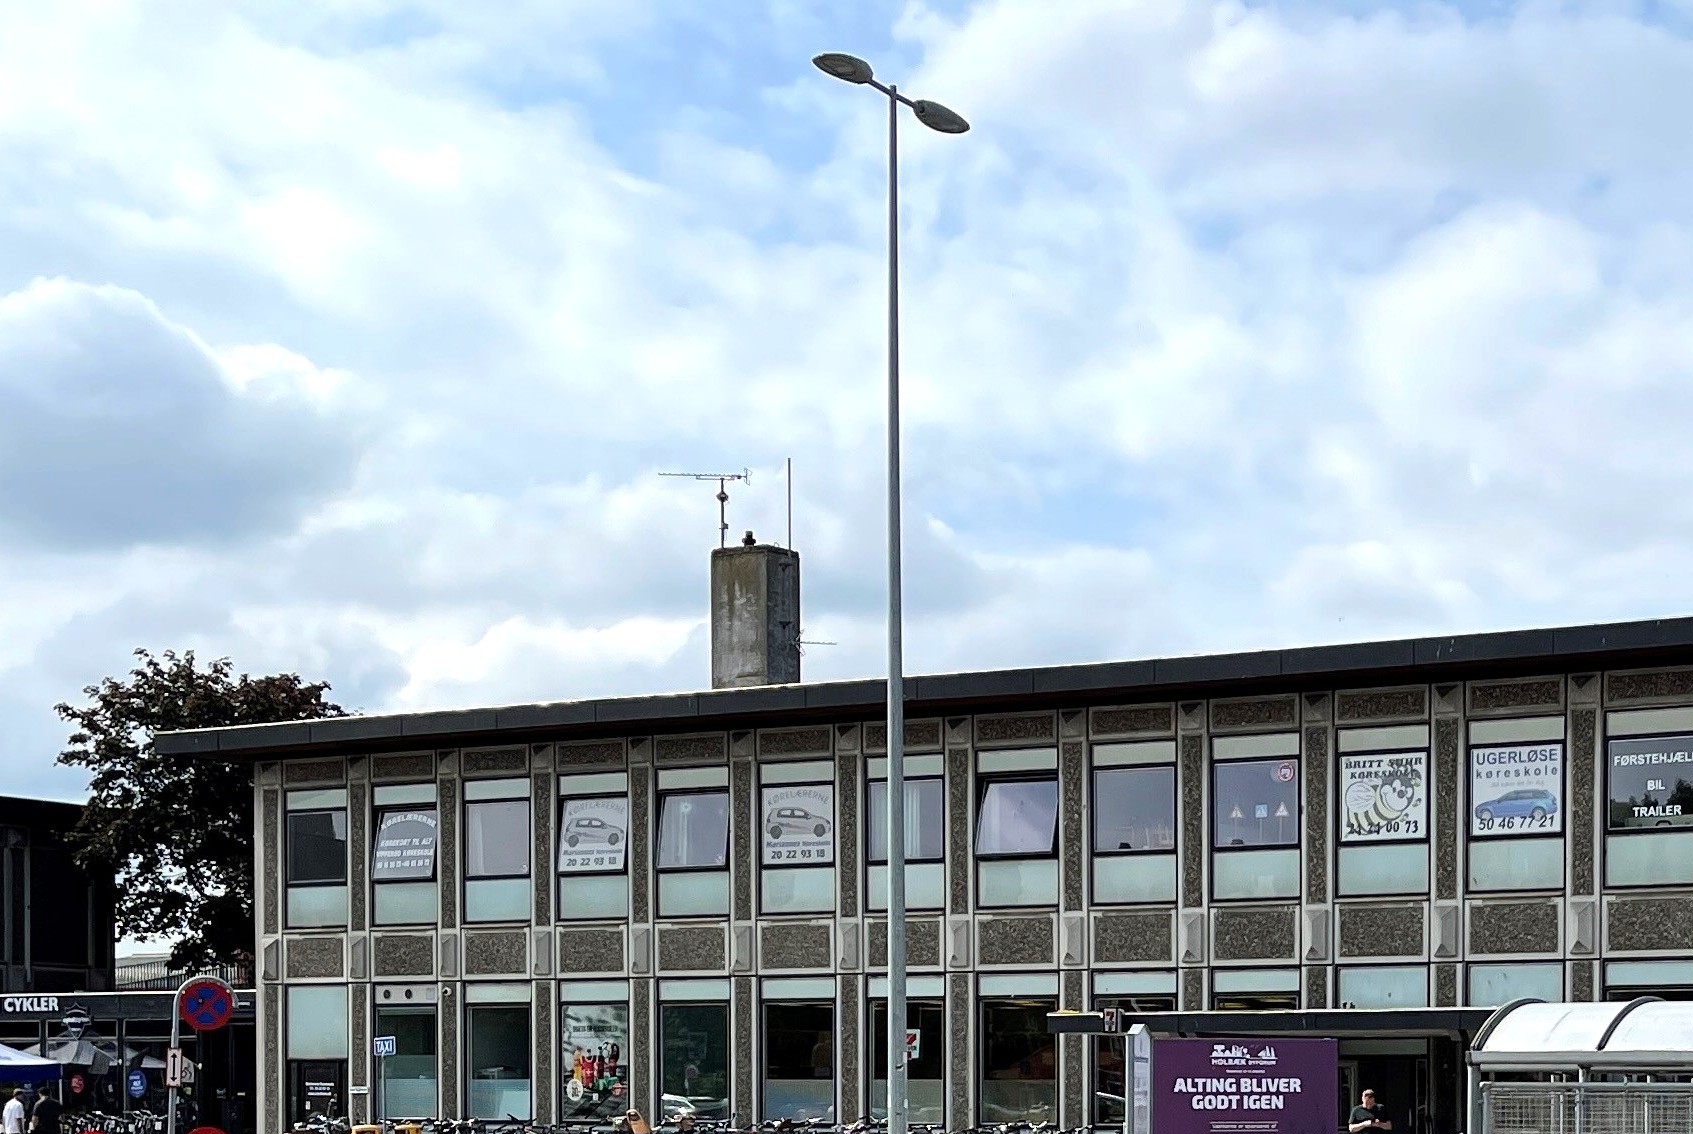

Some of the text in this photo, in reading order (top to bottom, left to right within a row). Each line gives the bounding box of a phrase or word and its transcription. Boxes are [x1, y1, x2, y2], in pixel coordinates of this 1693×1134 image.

[1345, 759, 1383, 769] BRITT
[1476, 749, 1558, 766] UGERLØSE
[1476, 765, 1558, 780] køreskole
[1647, 779, 1666, 791] BIL
[1632, 805, 1682, 818] TRAILER
[1386, 821, 1400, 833] 00
[1405, 819, 1419, 834] 73
[1478, 814, 1555, 831] 50 46 77 21
[566, 858, 577, 867] 20
[580, 857, 591, 866] 22
[593, 856, 605, 866] 93
[771, 850, 783, 860] 20
[786, 849, 797, 859] 22
[800, 849, 812, 859] 93
[4, 997, 59, 1013] CYKLER
[375, 1040, 393, 1053] TAXI
[1173, 1077, 1302, 1093] ALTING BLIVER
[1191, 1094, 1284, 1110] GODT IGEN
